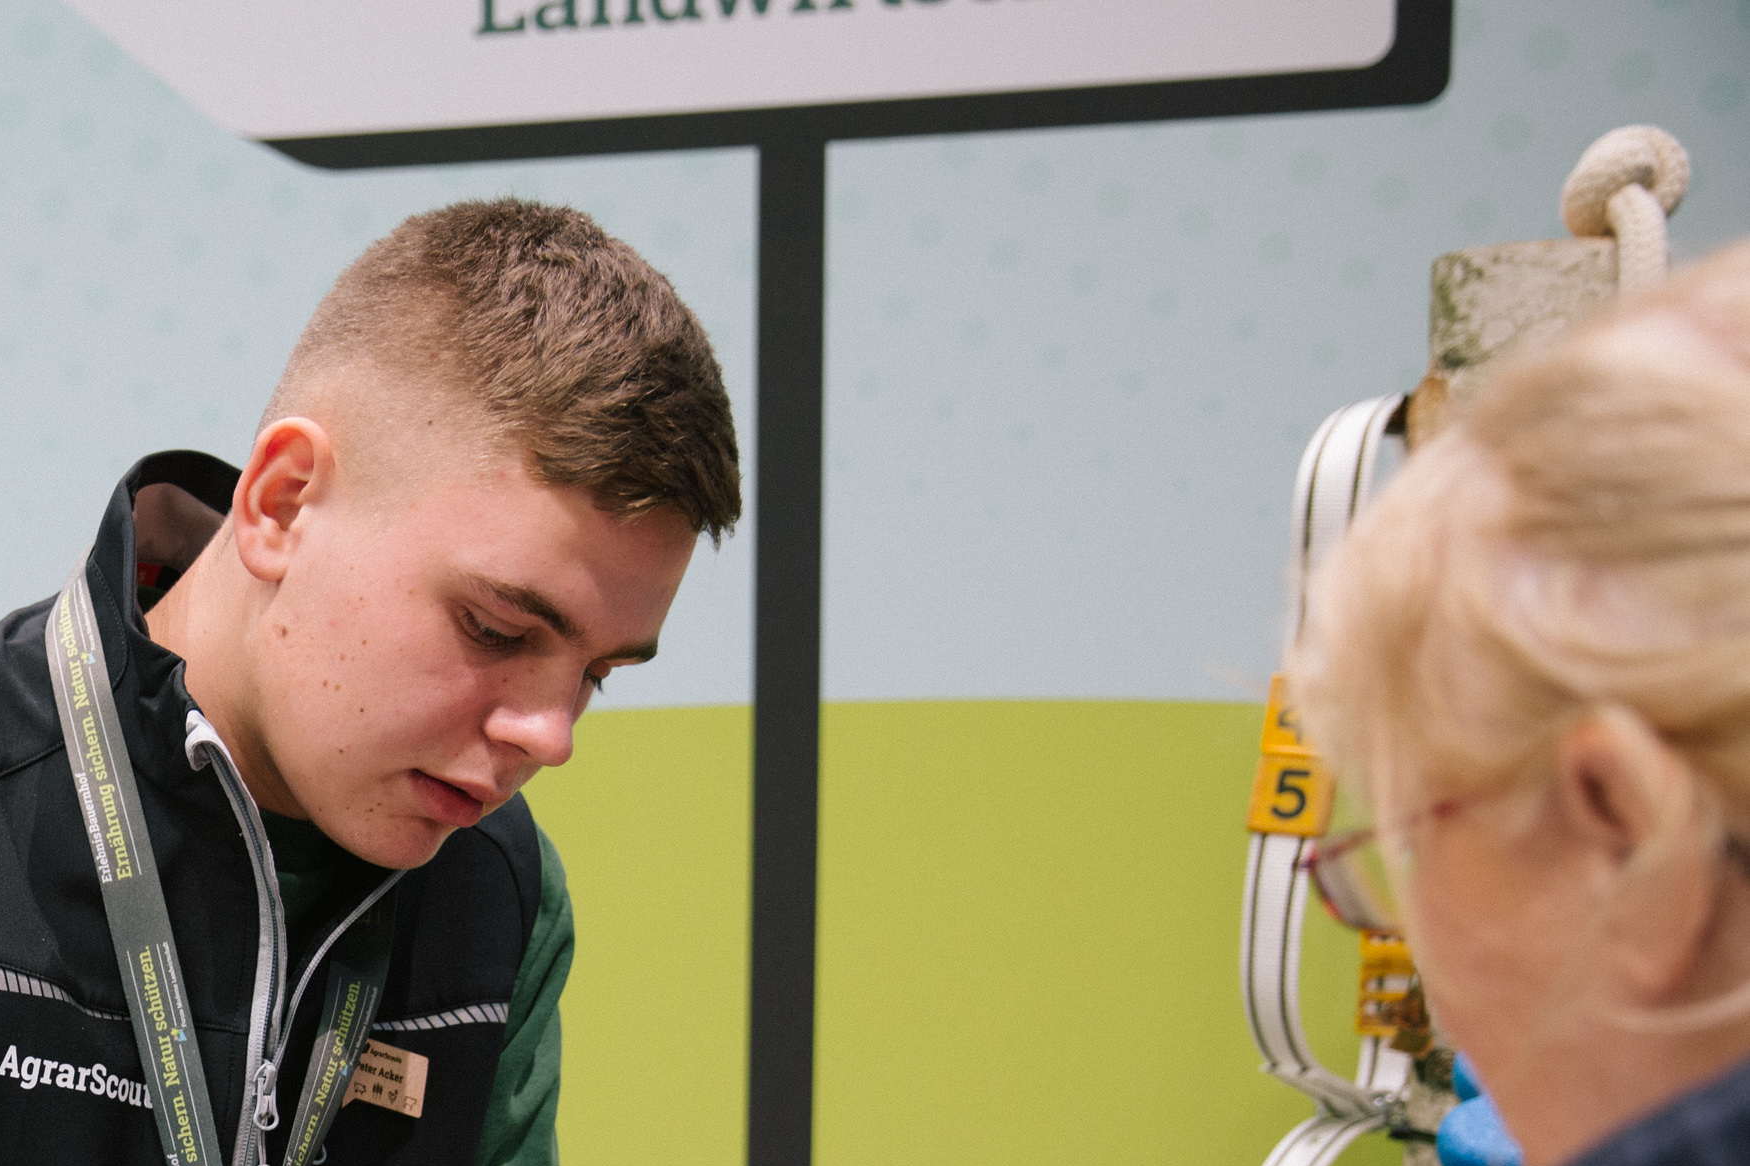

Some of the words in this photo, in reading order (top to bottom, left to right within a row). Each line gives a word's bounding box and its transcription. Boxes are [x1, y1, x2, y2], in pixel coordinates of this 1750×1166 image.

[67, 658, 90, 711] Natur
[82, 710, 108, 782] sichern.
[74, 771, 113, 884] ErlebnisBauernhof
[1270, 768, 1312, 820] 5
[98, 781, 133, 882] Ernährung
[137, 944, 169, 1033] schützen.
[156, 1034, 181, 1089] Natur
[313, 1055, 339, 1109] Natur
[331, 980, 362, 1057] schützen.
[377, 1066, 404, 1084] Acker
[172, 1089, 199, 1165] sichern.
